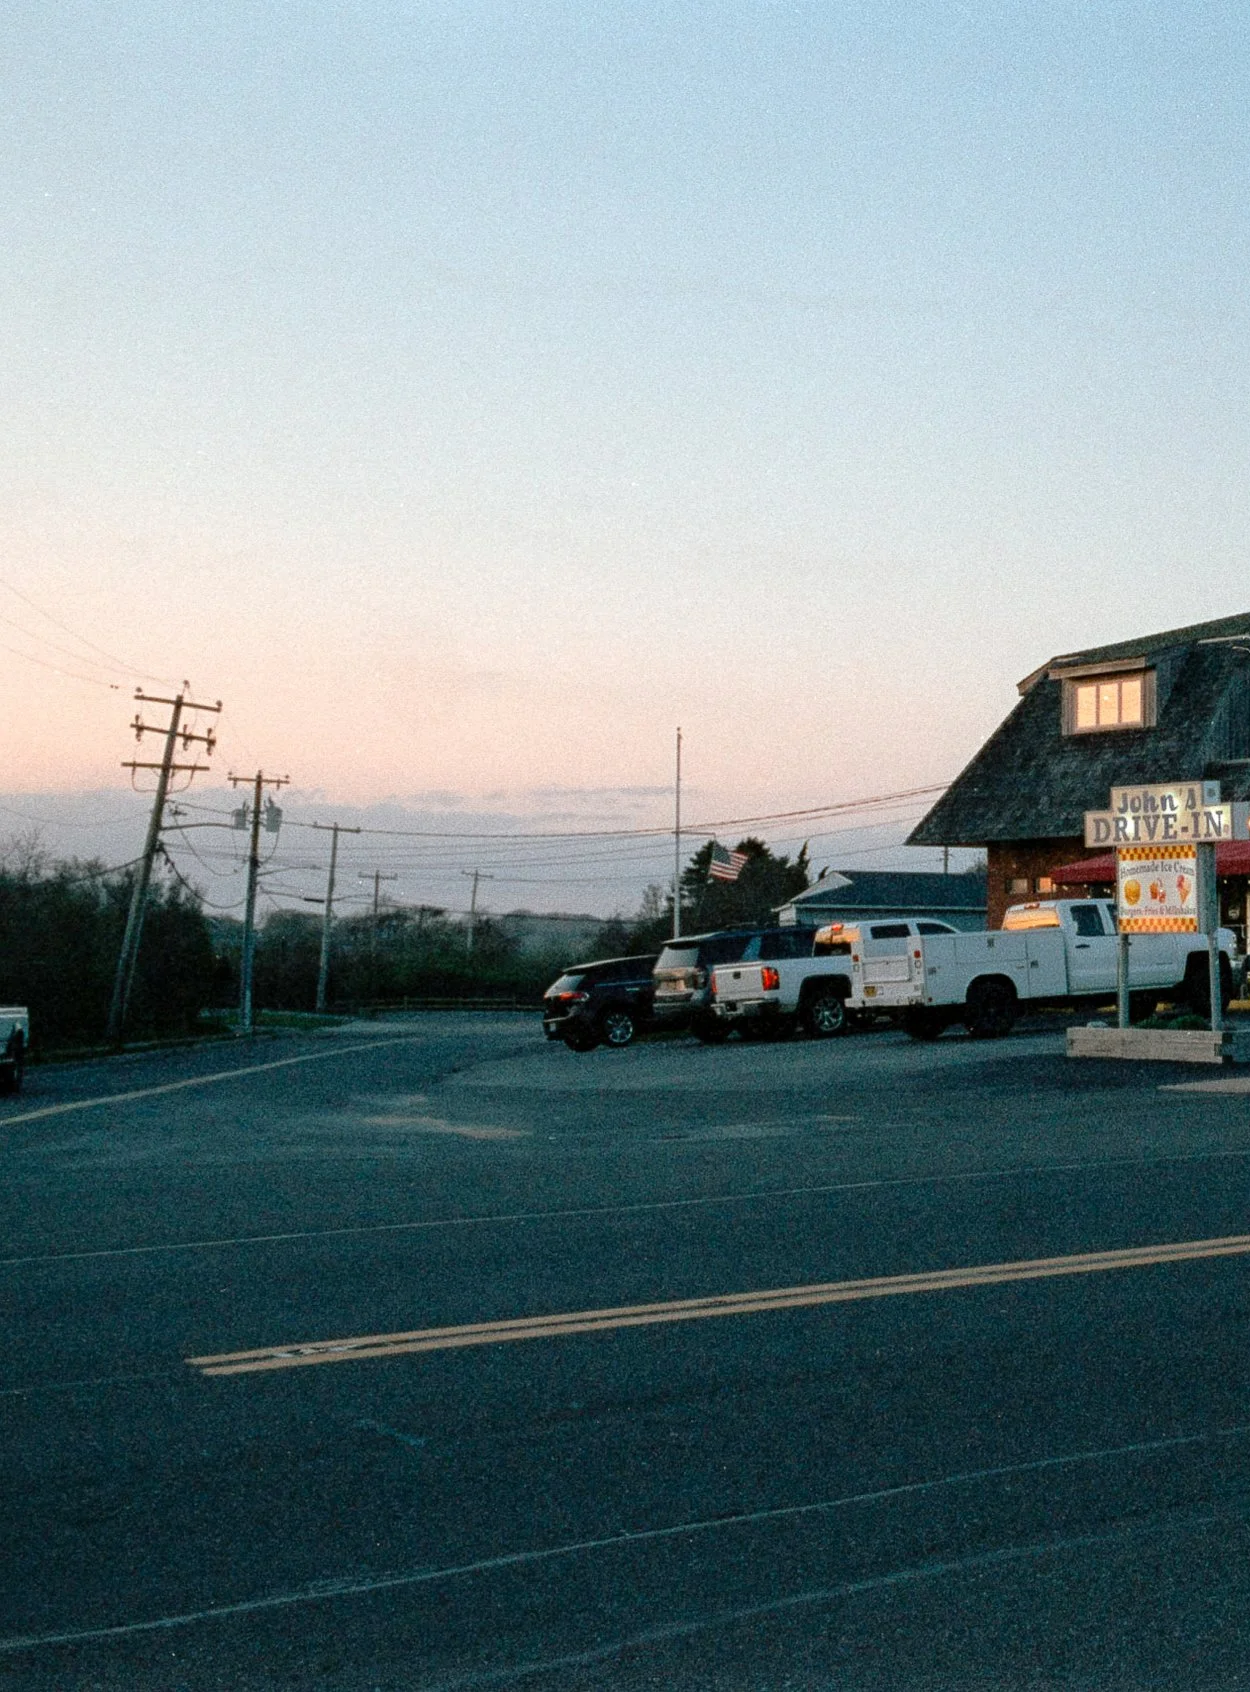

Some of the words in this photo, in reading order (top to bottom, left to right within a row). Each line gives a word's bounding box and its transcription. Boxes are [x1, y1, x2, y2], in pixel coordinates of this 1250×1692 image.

[1117, 787, 1197, 814] John's
[1093, 810, 1223, 843] DRIVE-IN
[1161, 861, 1173, 873] Ice
[1174, 861, 1195, 876] Cream
